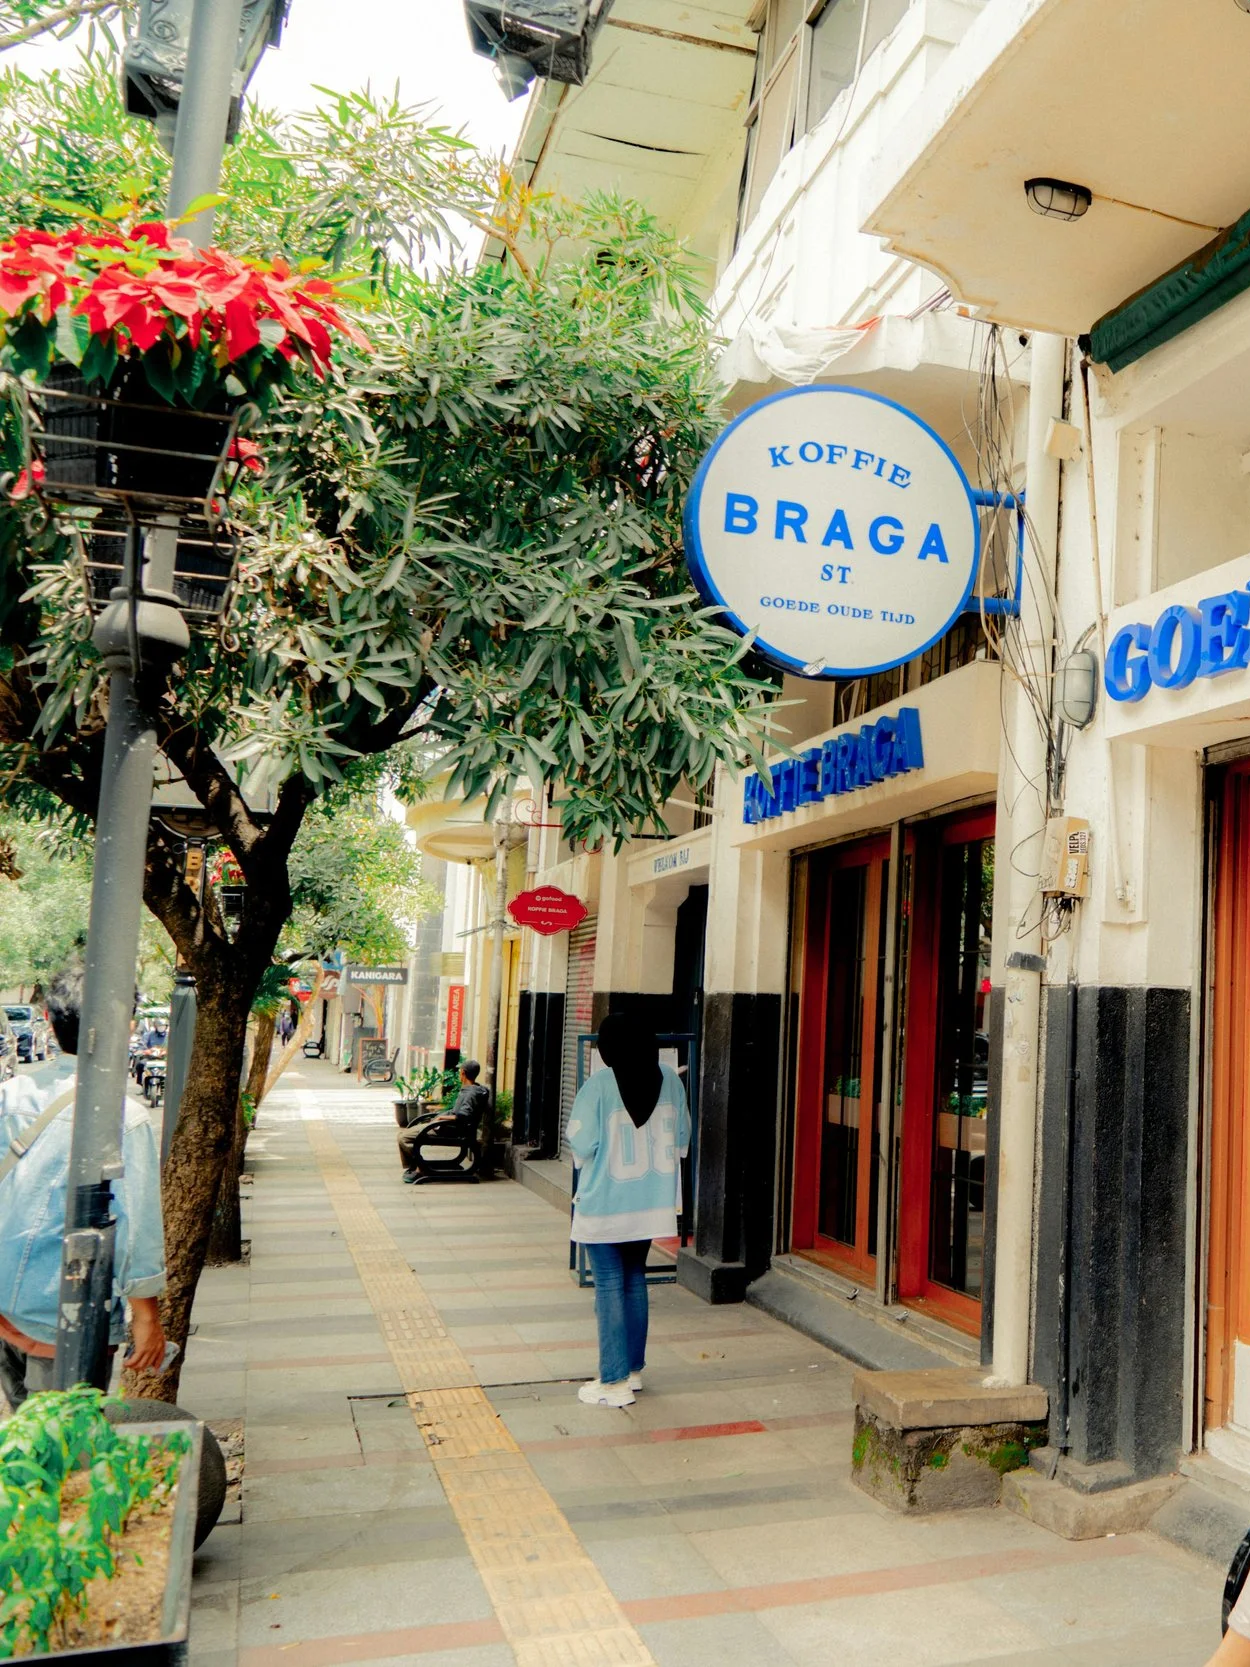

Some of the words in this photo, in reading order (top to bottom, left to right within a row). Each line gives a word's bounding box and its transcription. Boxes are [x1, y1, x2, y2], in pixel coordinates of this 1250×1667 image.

[768, 441, 911, 489] KOFFIE
[724, 492, 949, 563] BRAGA
[820, 564, 851, 584] ST
[760, 596, 820, 614] GOEDE
[827, 604, 873, 620] OUDE
[880, 610, 915, 625] TIJD
[821, 707, 924, 798] BRAGA
[351, 971, 403, 981] KANIGARA
[452, 988, 461, 1010] AREA
